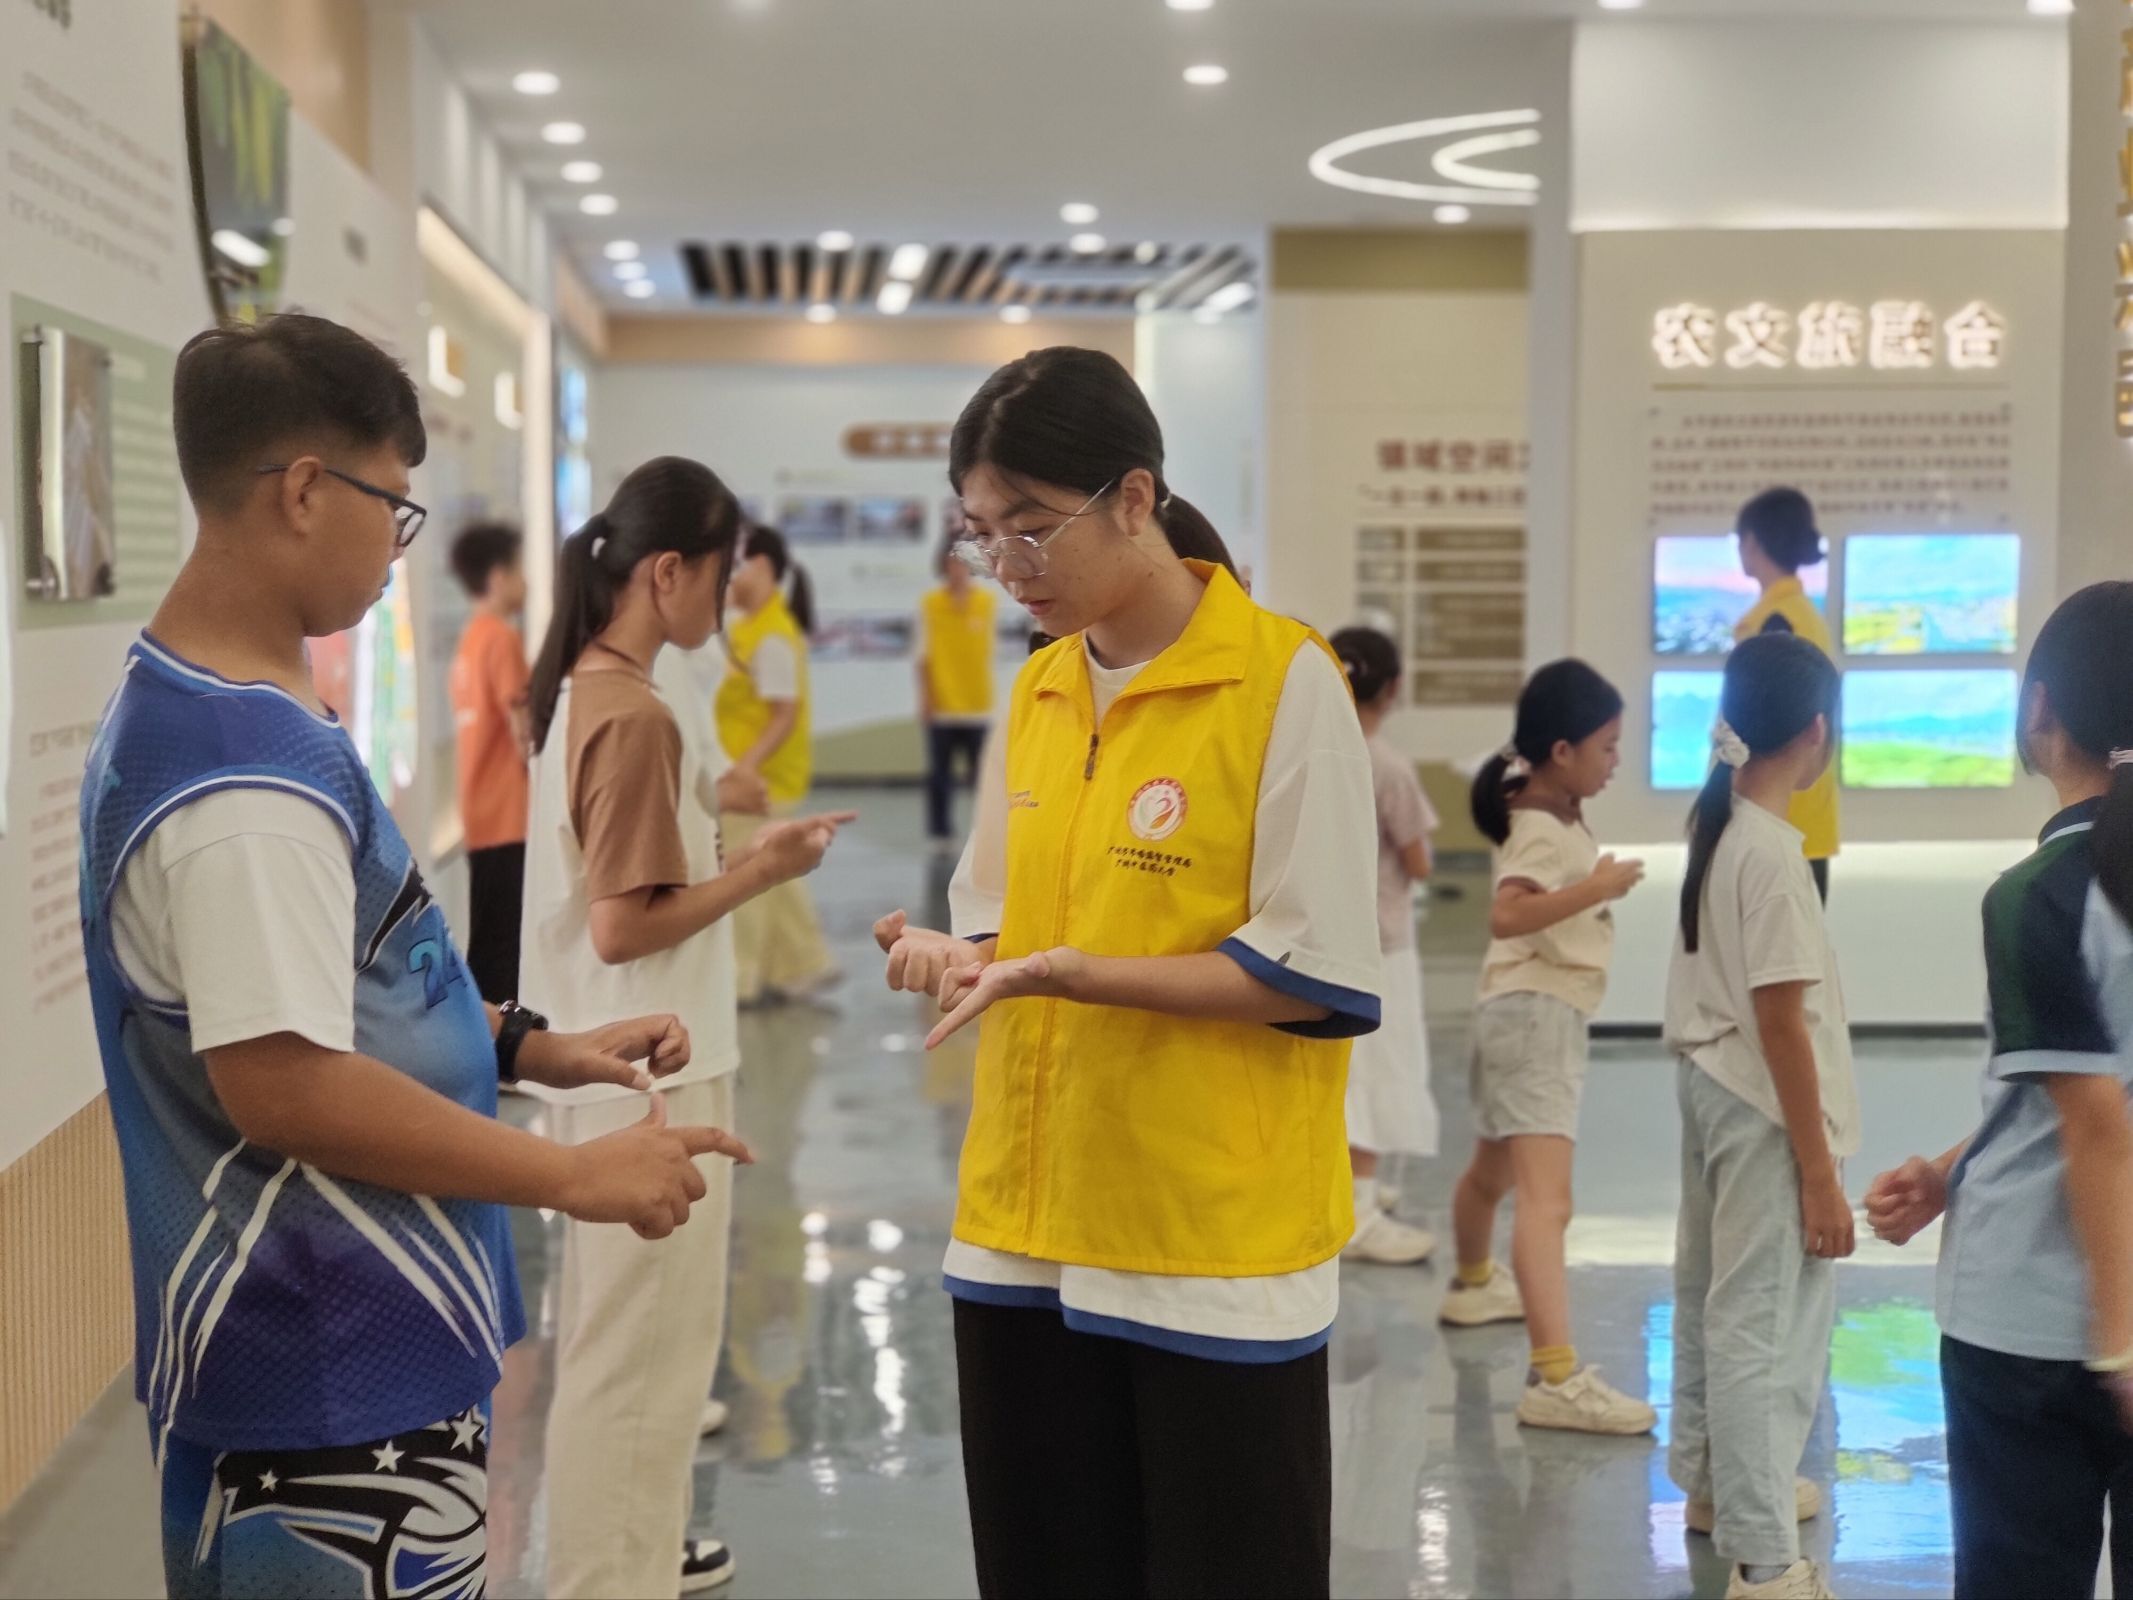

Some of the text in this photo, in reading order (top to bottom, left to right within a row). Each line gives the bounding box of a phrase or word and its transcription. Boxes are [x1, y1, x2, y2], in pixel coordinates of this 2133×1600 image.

[1652, 301, 2005, 369] 农文旅融合
